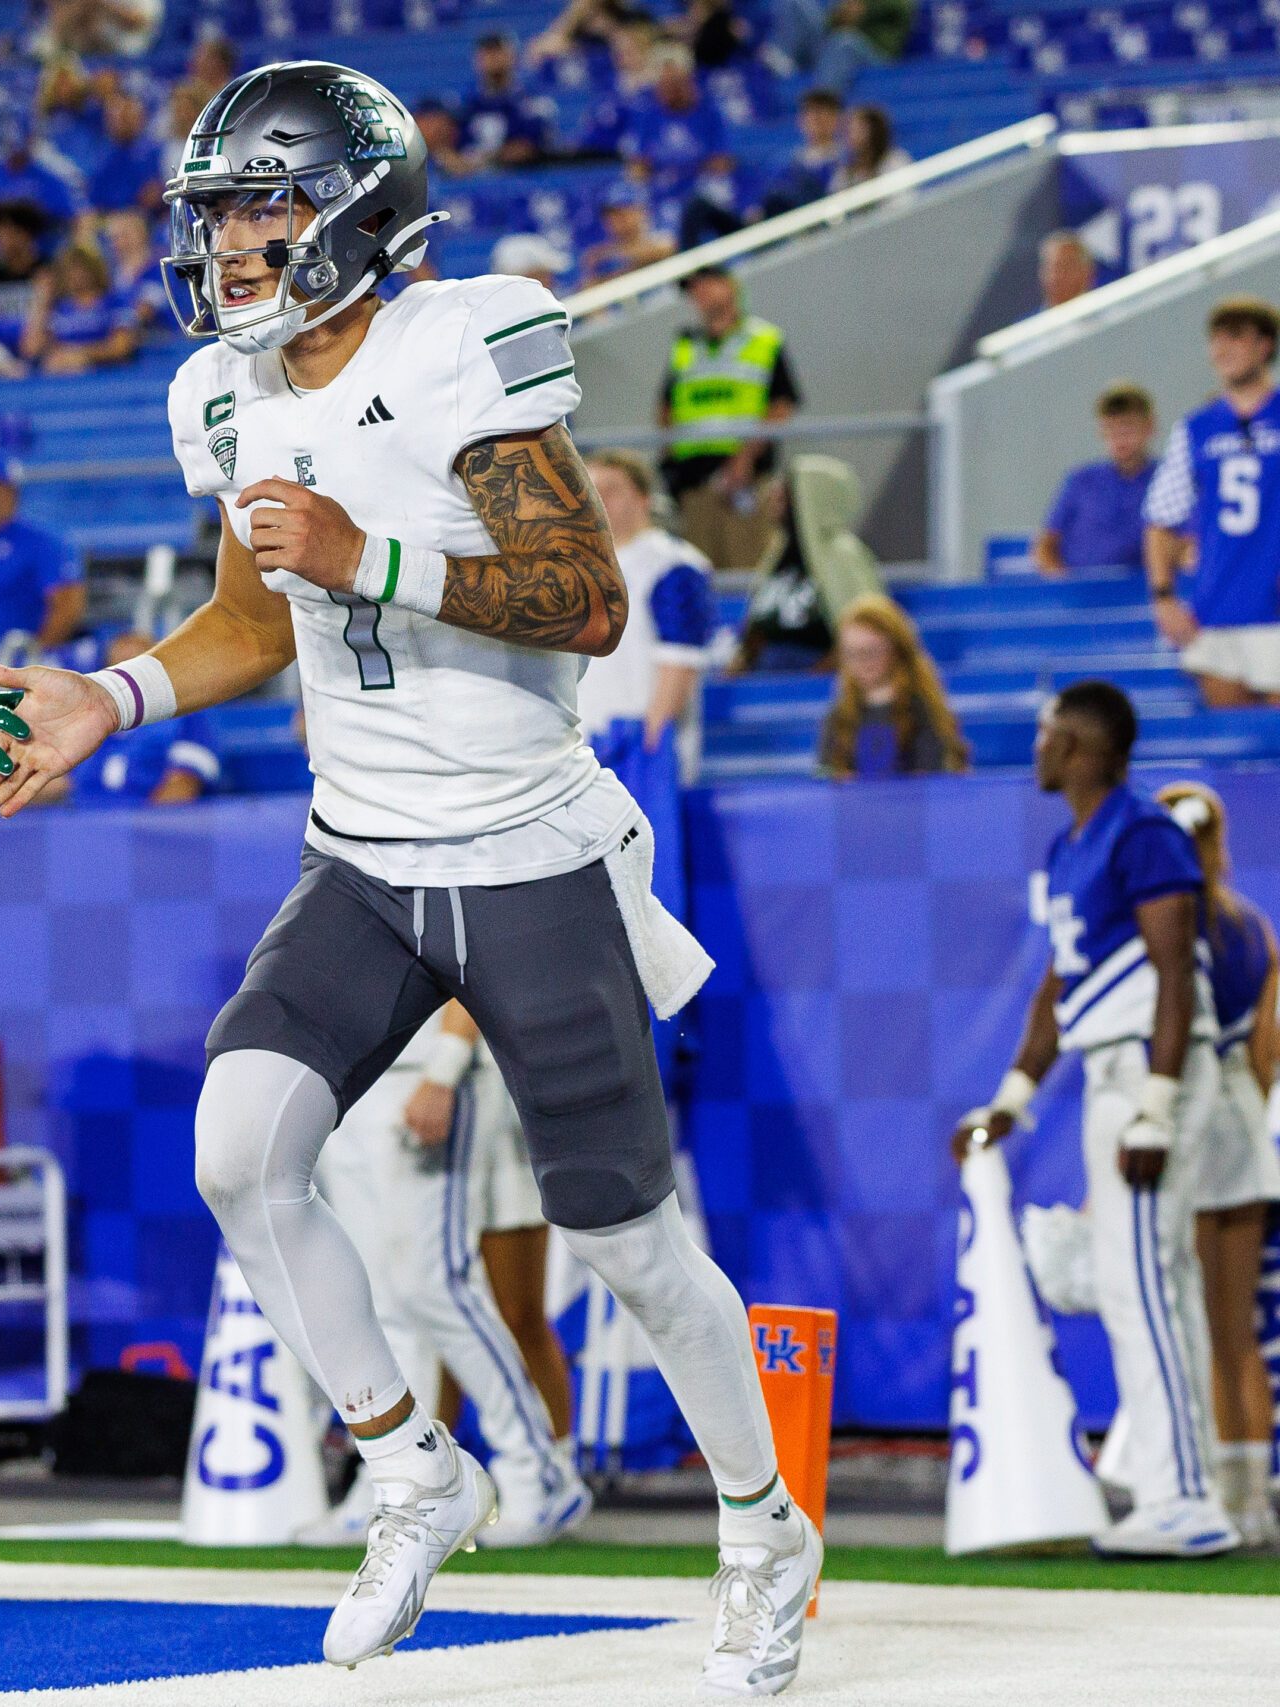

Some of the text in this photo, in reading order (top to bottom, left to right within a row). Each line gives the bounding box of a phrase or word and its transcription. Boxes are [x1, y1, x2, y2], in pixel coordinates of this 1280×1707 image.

[1130, 181, 1219, 270] 23
[205, 394, 233, 428] C
[294, 455, 317, 486] E
[1218, 457, 1262, 536] 5
[198, 1234, 285, 1490] CAT
[753, 1324, 807, 1374] UK
